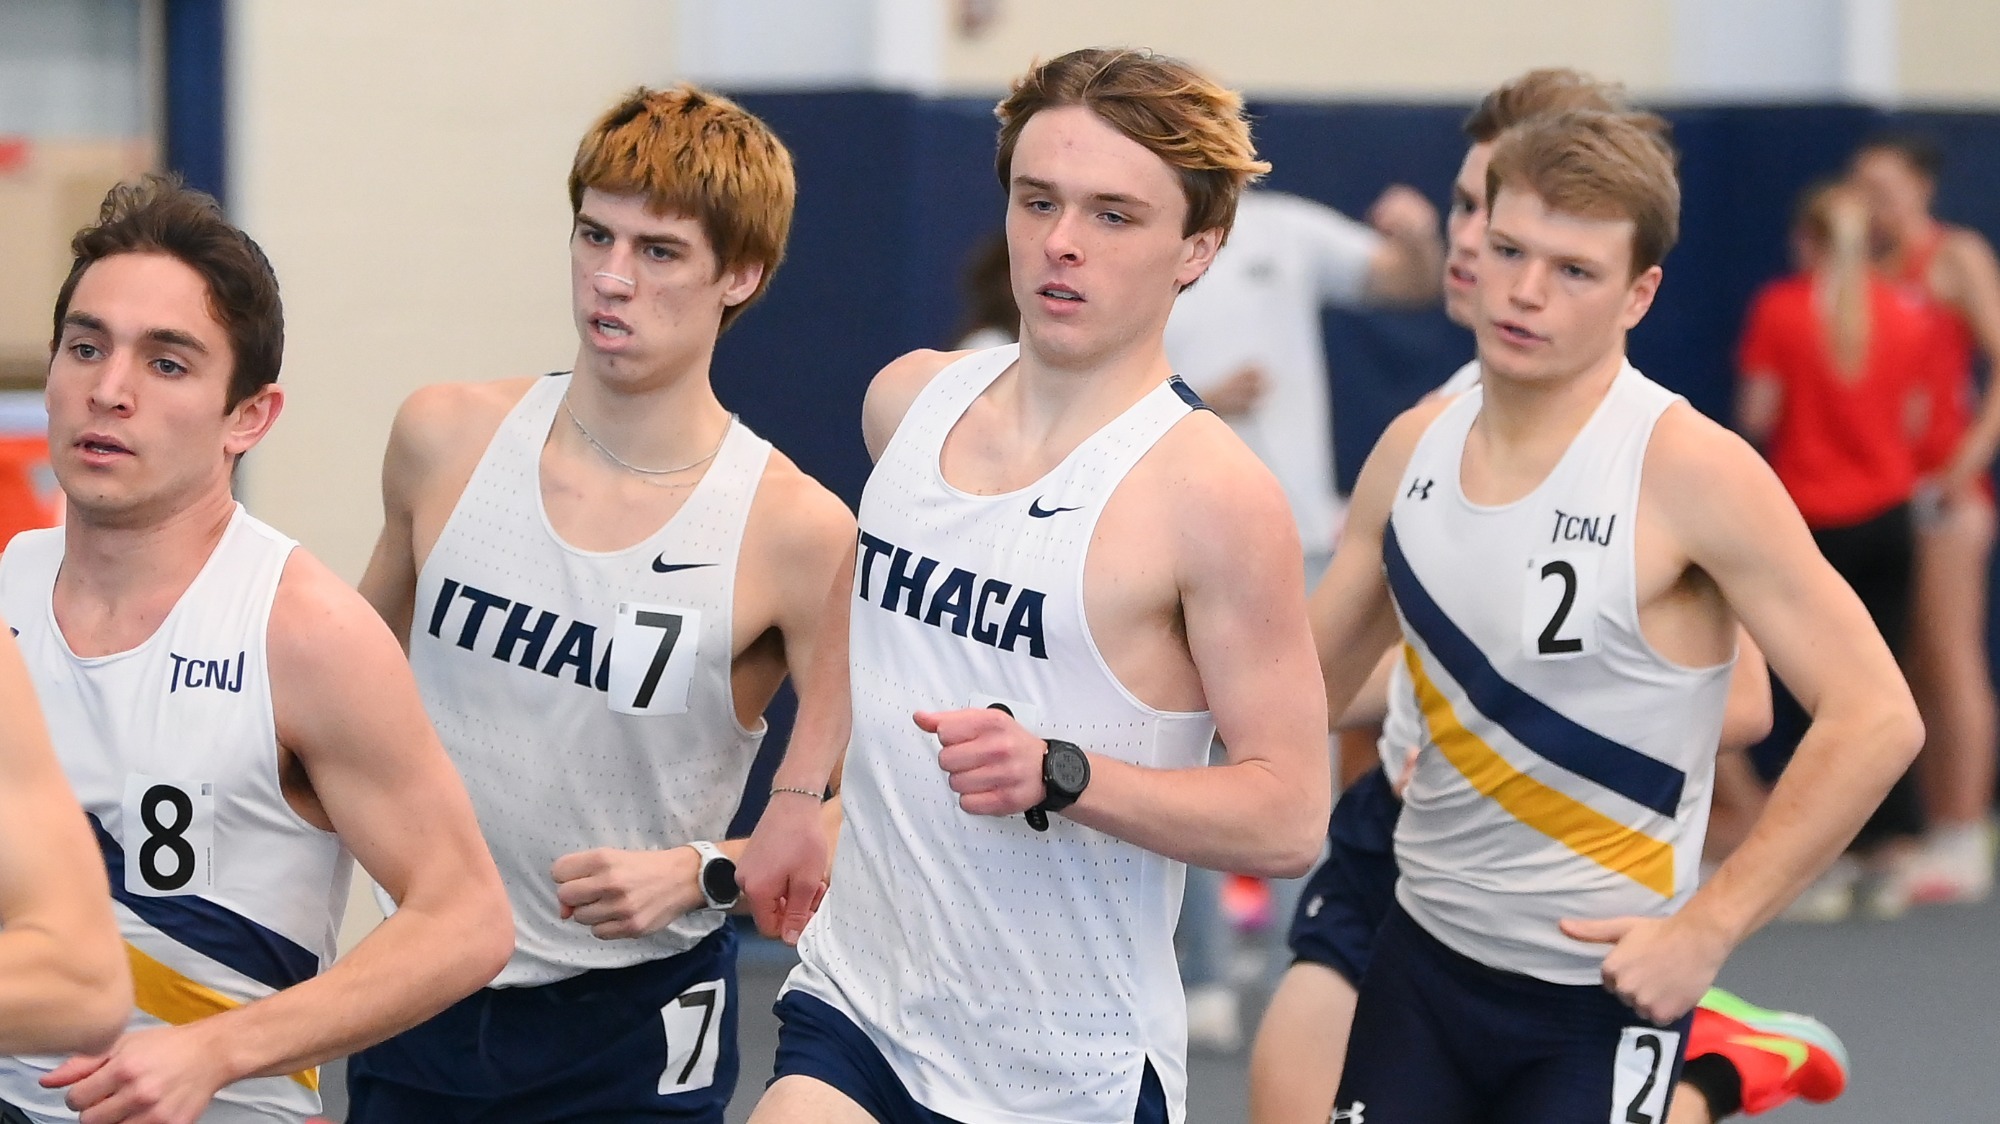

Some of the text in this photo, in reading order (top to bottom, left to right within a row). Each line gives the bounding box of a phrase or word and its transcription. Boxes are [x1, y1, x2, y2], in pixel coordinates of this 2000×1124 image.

[1552, 509, 1616, 547] TCNJ
[853, 527, 1049, 660] THACA
[1537, 560, 1582, 655] 2
[169, 650, 245, 694] TCNJ
[631, 610, 683, 709] 7
[139, 784, 195, 891] 8
[676, 988, 717, 1085] 7
[1625, 1033, 1662, 1124] 2
